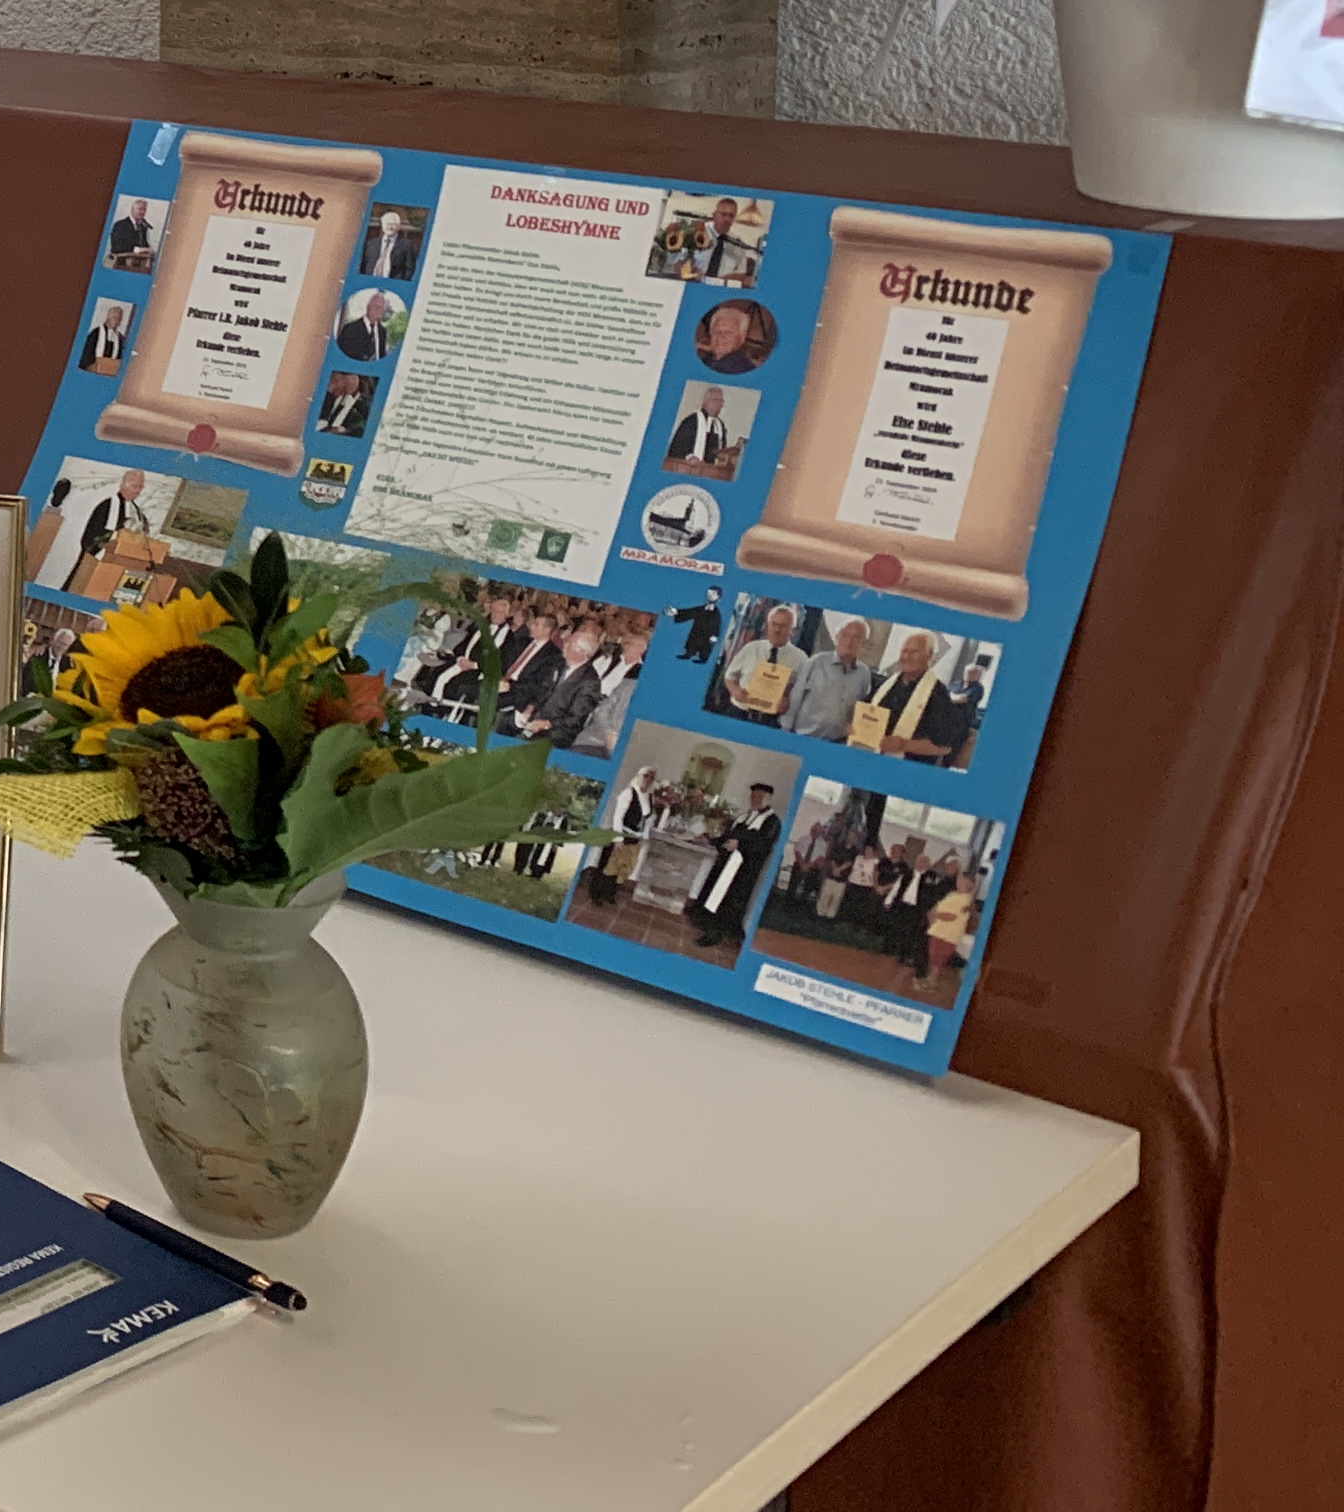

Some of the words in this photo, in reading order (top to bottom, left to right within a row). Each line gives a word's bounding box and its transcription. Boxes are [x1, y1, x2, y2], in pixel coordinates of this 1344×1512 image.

[490, 185, 610, 213] DANKSAGUNG
[614, 199, 650, 217] UND
[505, 213, 622, 241] LOBESHYMNE
[622, 548, 722, 573] MRAMORAK
[766, 970, 806, 989] JAKOB
[808, 979, 856, 1004] STEHLE
[864, 999, 925, 1025] PFARRER
